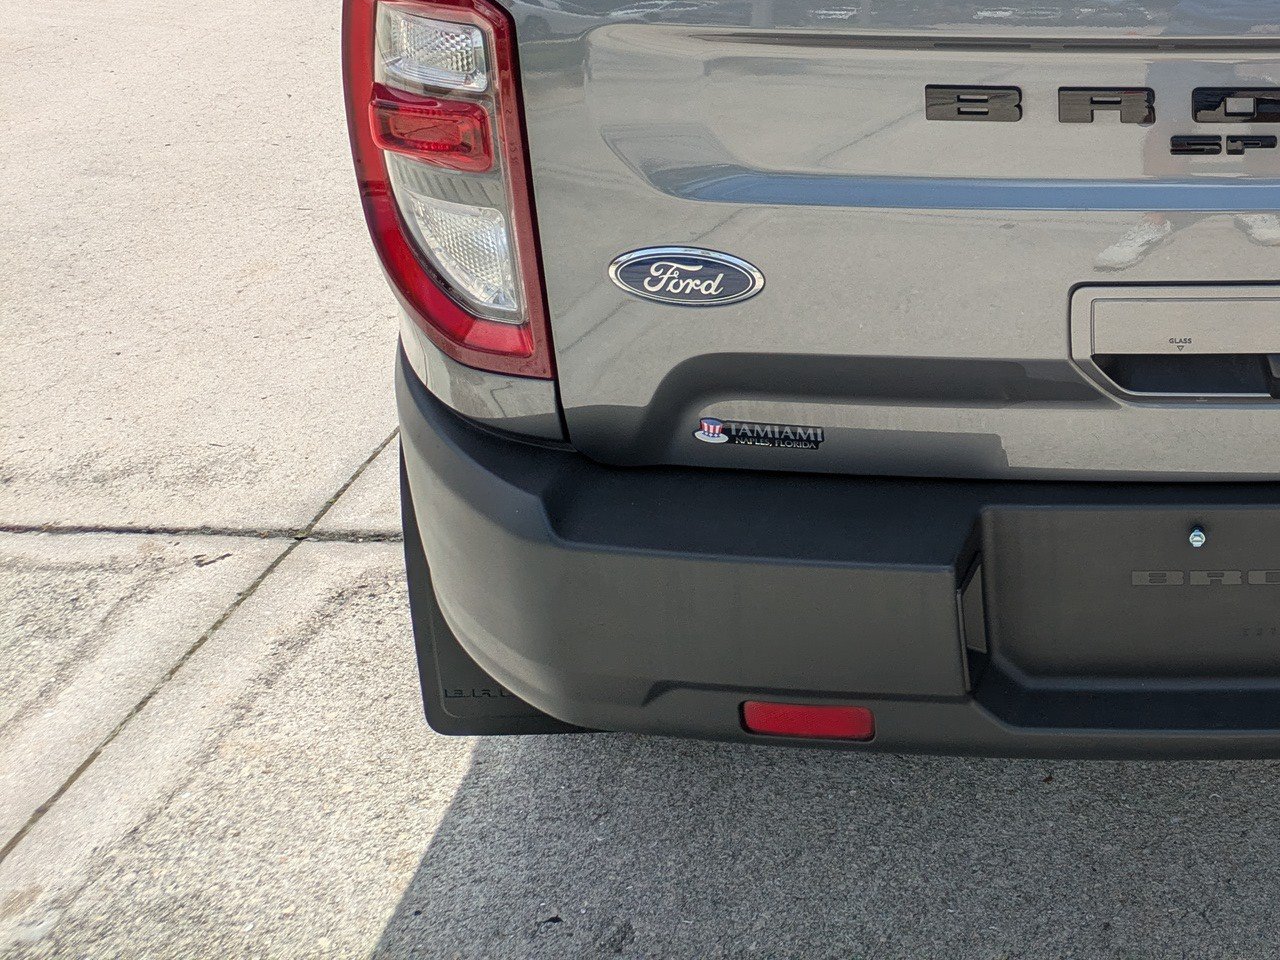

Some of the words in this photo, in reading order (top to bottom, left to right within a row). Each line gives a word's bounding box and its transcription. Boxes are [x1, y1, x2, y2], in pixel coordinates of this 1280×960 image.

[643, 261, 725, 295] Ford
[729, 422, 823, 442] TAMIAMI
[774, 440, 817, 449] FLORIDA
